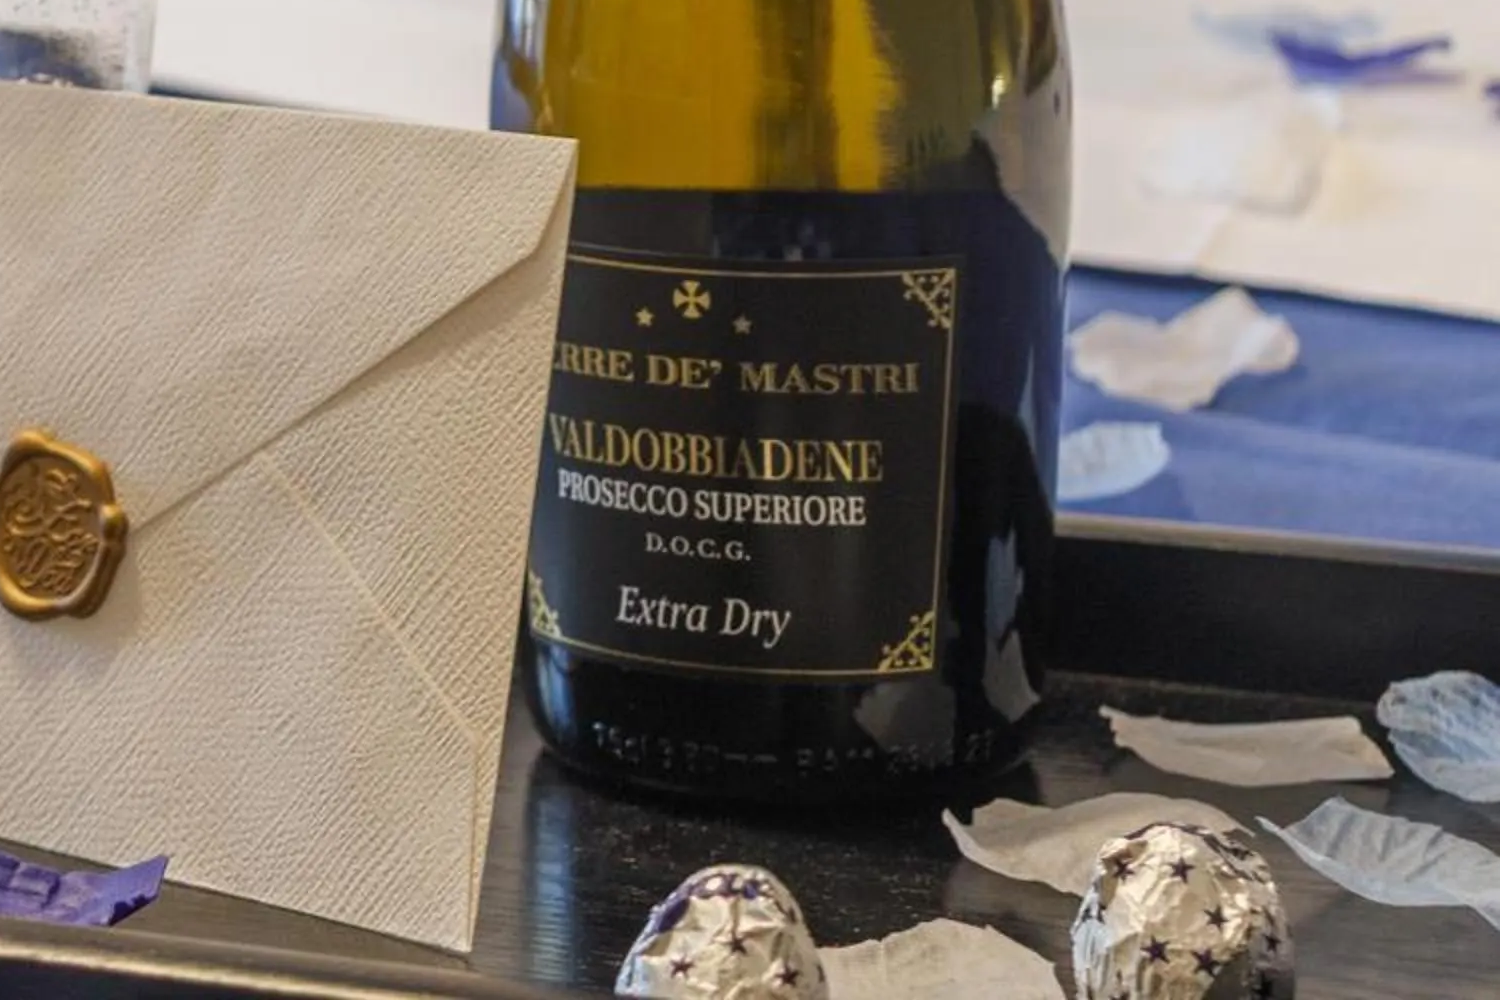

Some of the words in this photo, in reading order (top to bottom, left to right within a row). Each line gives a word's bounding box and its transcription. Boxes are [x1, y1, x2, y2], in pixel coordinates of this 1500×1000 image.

[740, 361, 920, 394] MASTRI
[549, 412, 884, 482] VALDOBBIADENE
[557, 468, 689, 518] PROSECCO
[694, 488, 867, 527] SUPERIORE
[645, 532, 751, 562] D.O.C.G.
[616, 585, 709, 634] Extra
[718, 598, 792, 649] Dry
